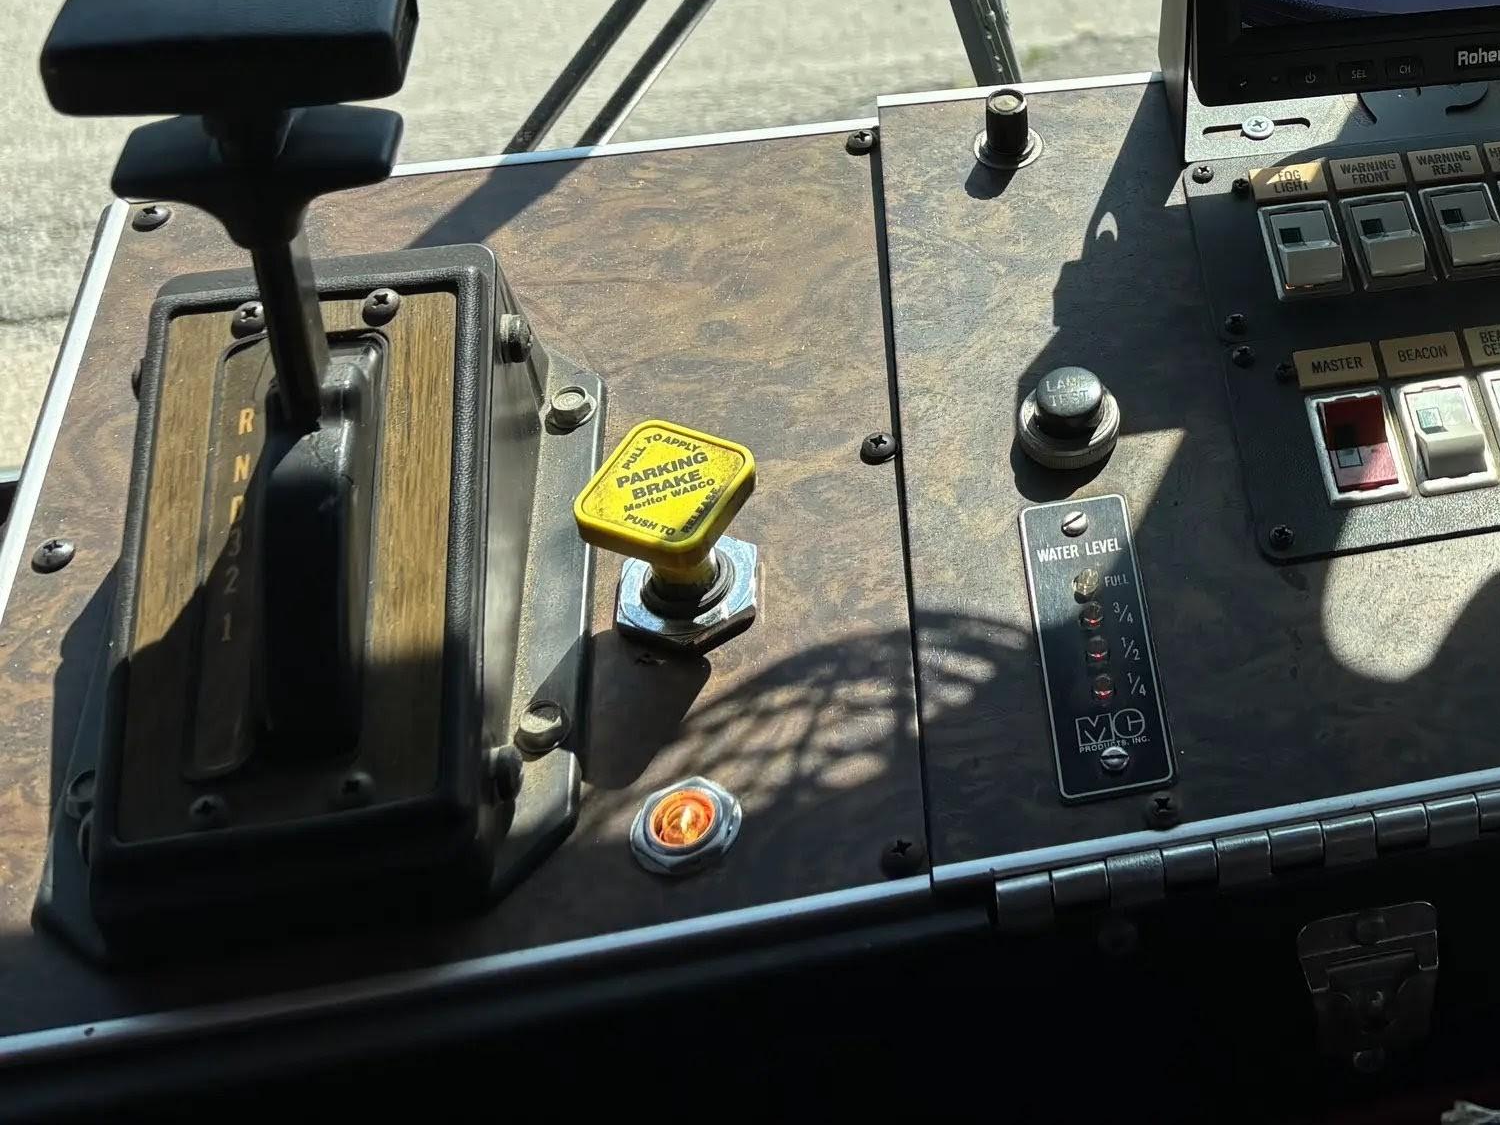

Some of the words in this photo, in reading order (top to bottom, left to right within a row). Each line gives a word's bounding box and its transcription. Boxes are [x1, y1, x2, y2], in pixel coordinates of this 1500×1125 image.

[1350, 67, 1368, 80] SEL
[1399, 63, 1412, 76] CH
[1339, 158, 1397, 176] WARNING
[1415, 150, 1472, 167] WARNING
[1432, 162, 1464, 176] REAR
[1273, 179, 1310, 194] LIGHT
[1277, 169, 1301, 183] FOG
[1352, 170, 1391, 185] FRONT
[1397, 345, 1449, 363] BEACON
[1311, 356, 1364, 374] MASTER
[1046, 374, 1087, 392] LAMP
[1048, 389, 1089, 407] TEST
[238, 407, 254, 436] R
[622, 445, 646, 470] PULL
[643, 433, 663, 445] TO
[661, 436, 702, 453] APPLY
[233, 452, 251, 483] N
[616, 451, 709, 489] PARKING
[623, 493, 668, 513] Meritor
[671, 478, 716, 499] WABCO
[631, 469, 703, 501] BRAKE
[624, 513, 658, 532] PUSH
[659, 525, 677, 537] TO
[680, 485, 722, 534] RELEASE
[228, 527, 243, 556] 3
[1036, 543, 1080, 563] WATER
[1084, 537, 1123, 557] LEVEL
[223, 566, 240, 595] 2
[1104, 574, 1130, 587] FULL
[1112, 601, 1134, 625] 3/4
[221, 612, 233, 642] 1
[1120, 636, 1142, 662] 1/2
[1127, 672, 1148, 698] 1/4
[1131, 734, 1151, 745] INC.
